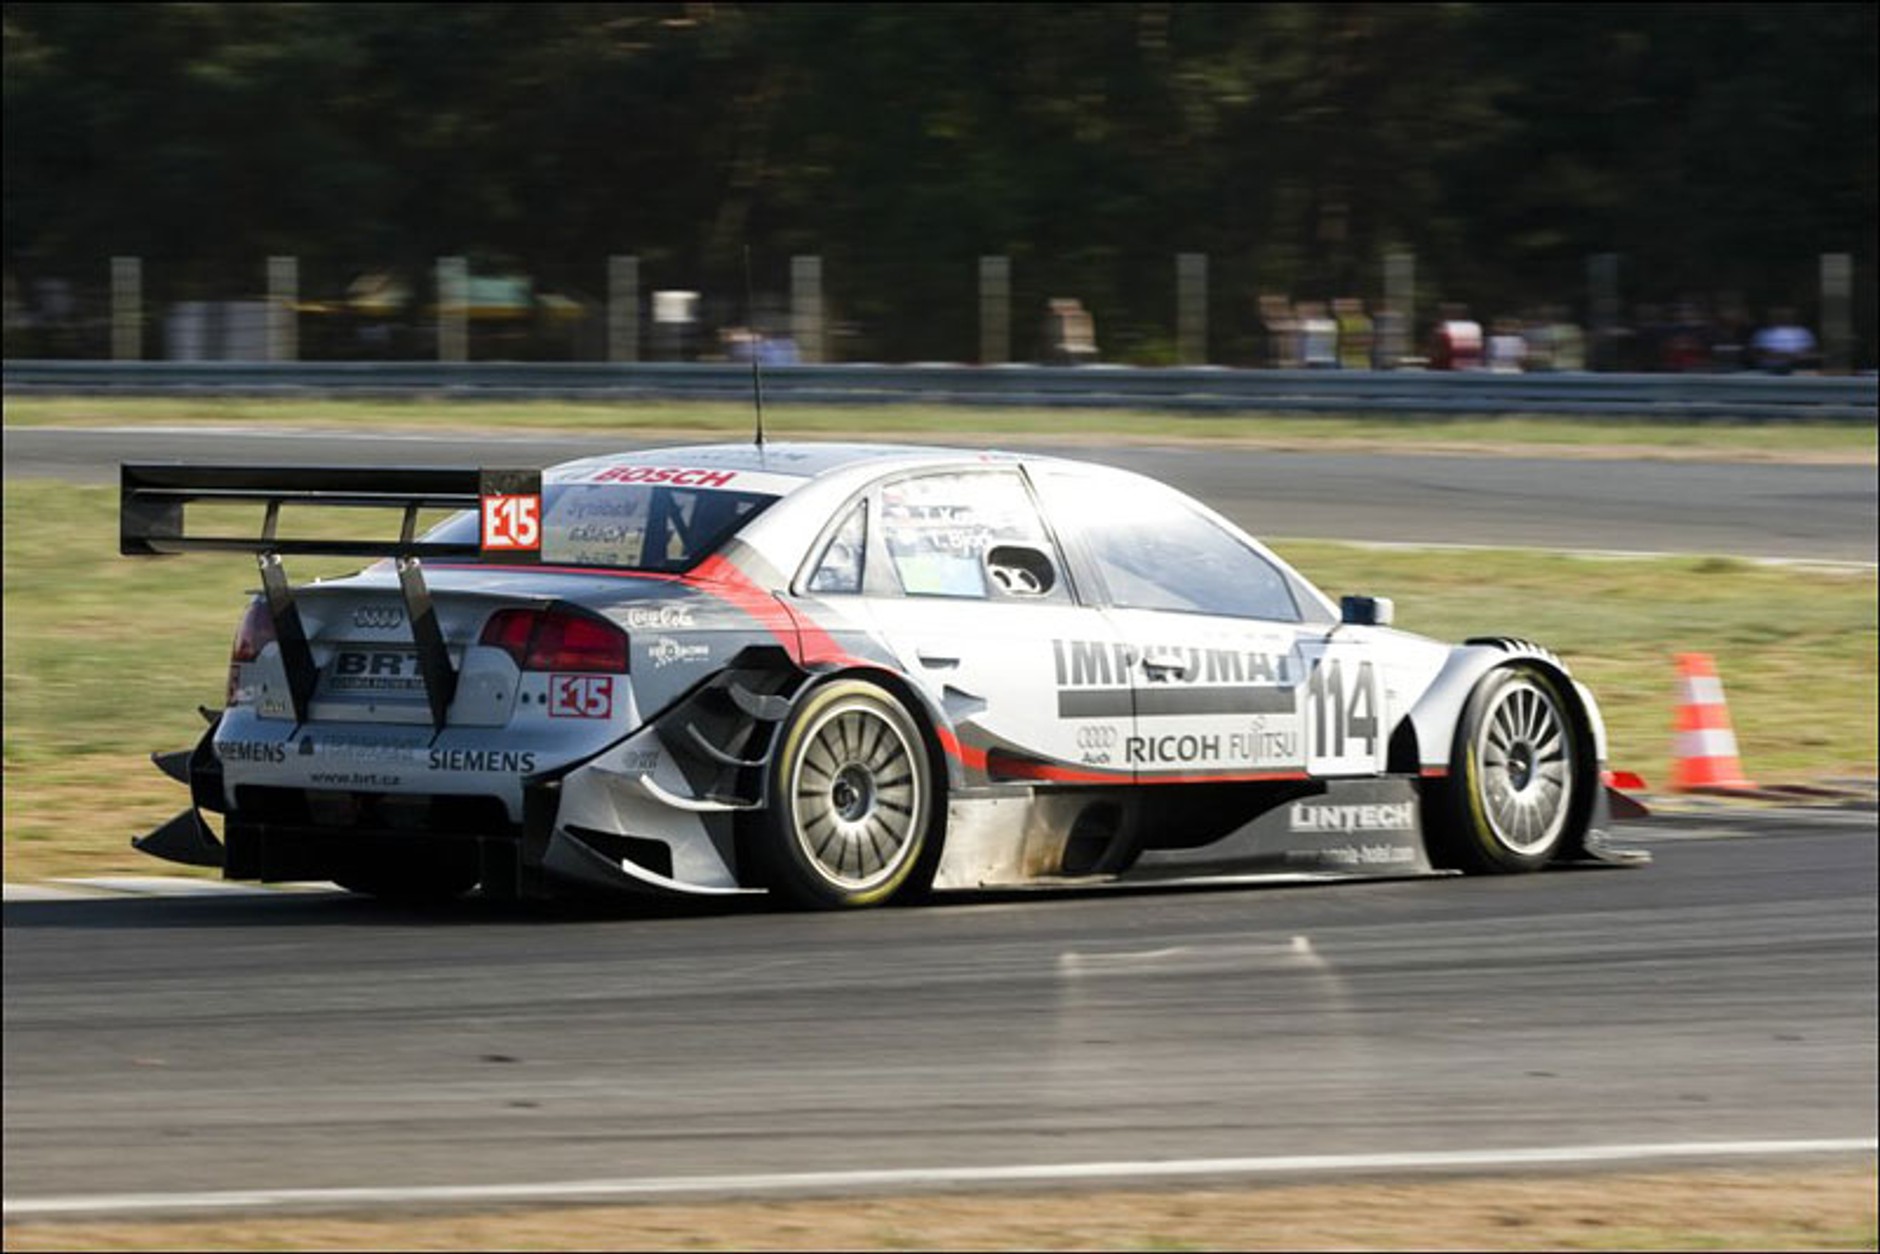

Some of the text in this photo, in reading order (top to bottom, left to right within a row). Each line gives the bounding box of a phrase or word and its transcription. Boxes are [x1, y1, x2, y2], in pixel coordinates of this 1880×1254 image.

[594, 465, 736, 487] BOSCH
[484, 496, 540, 547] E15
[551, 676, 610, 717] E15
[1307, 657, 1377, 757] 114
[428, 750, 535, 773] SIEMENS
[1125, 734, 1220, 763] RICOH
[1230, 732, 1297, 761] FUJITSU
[1291, 802, 1414, 833] LINTECH
